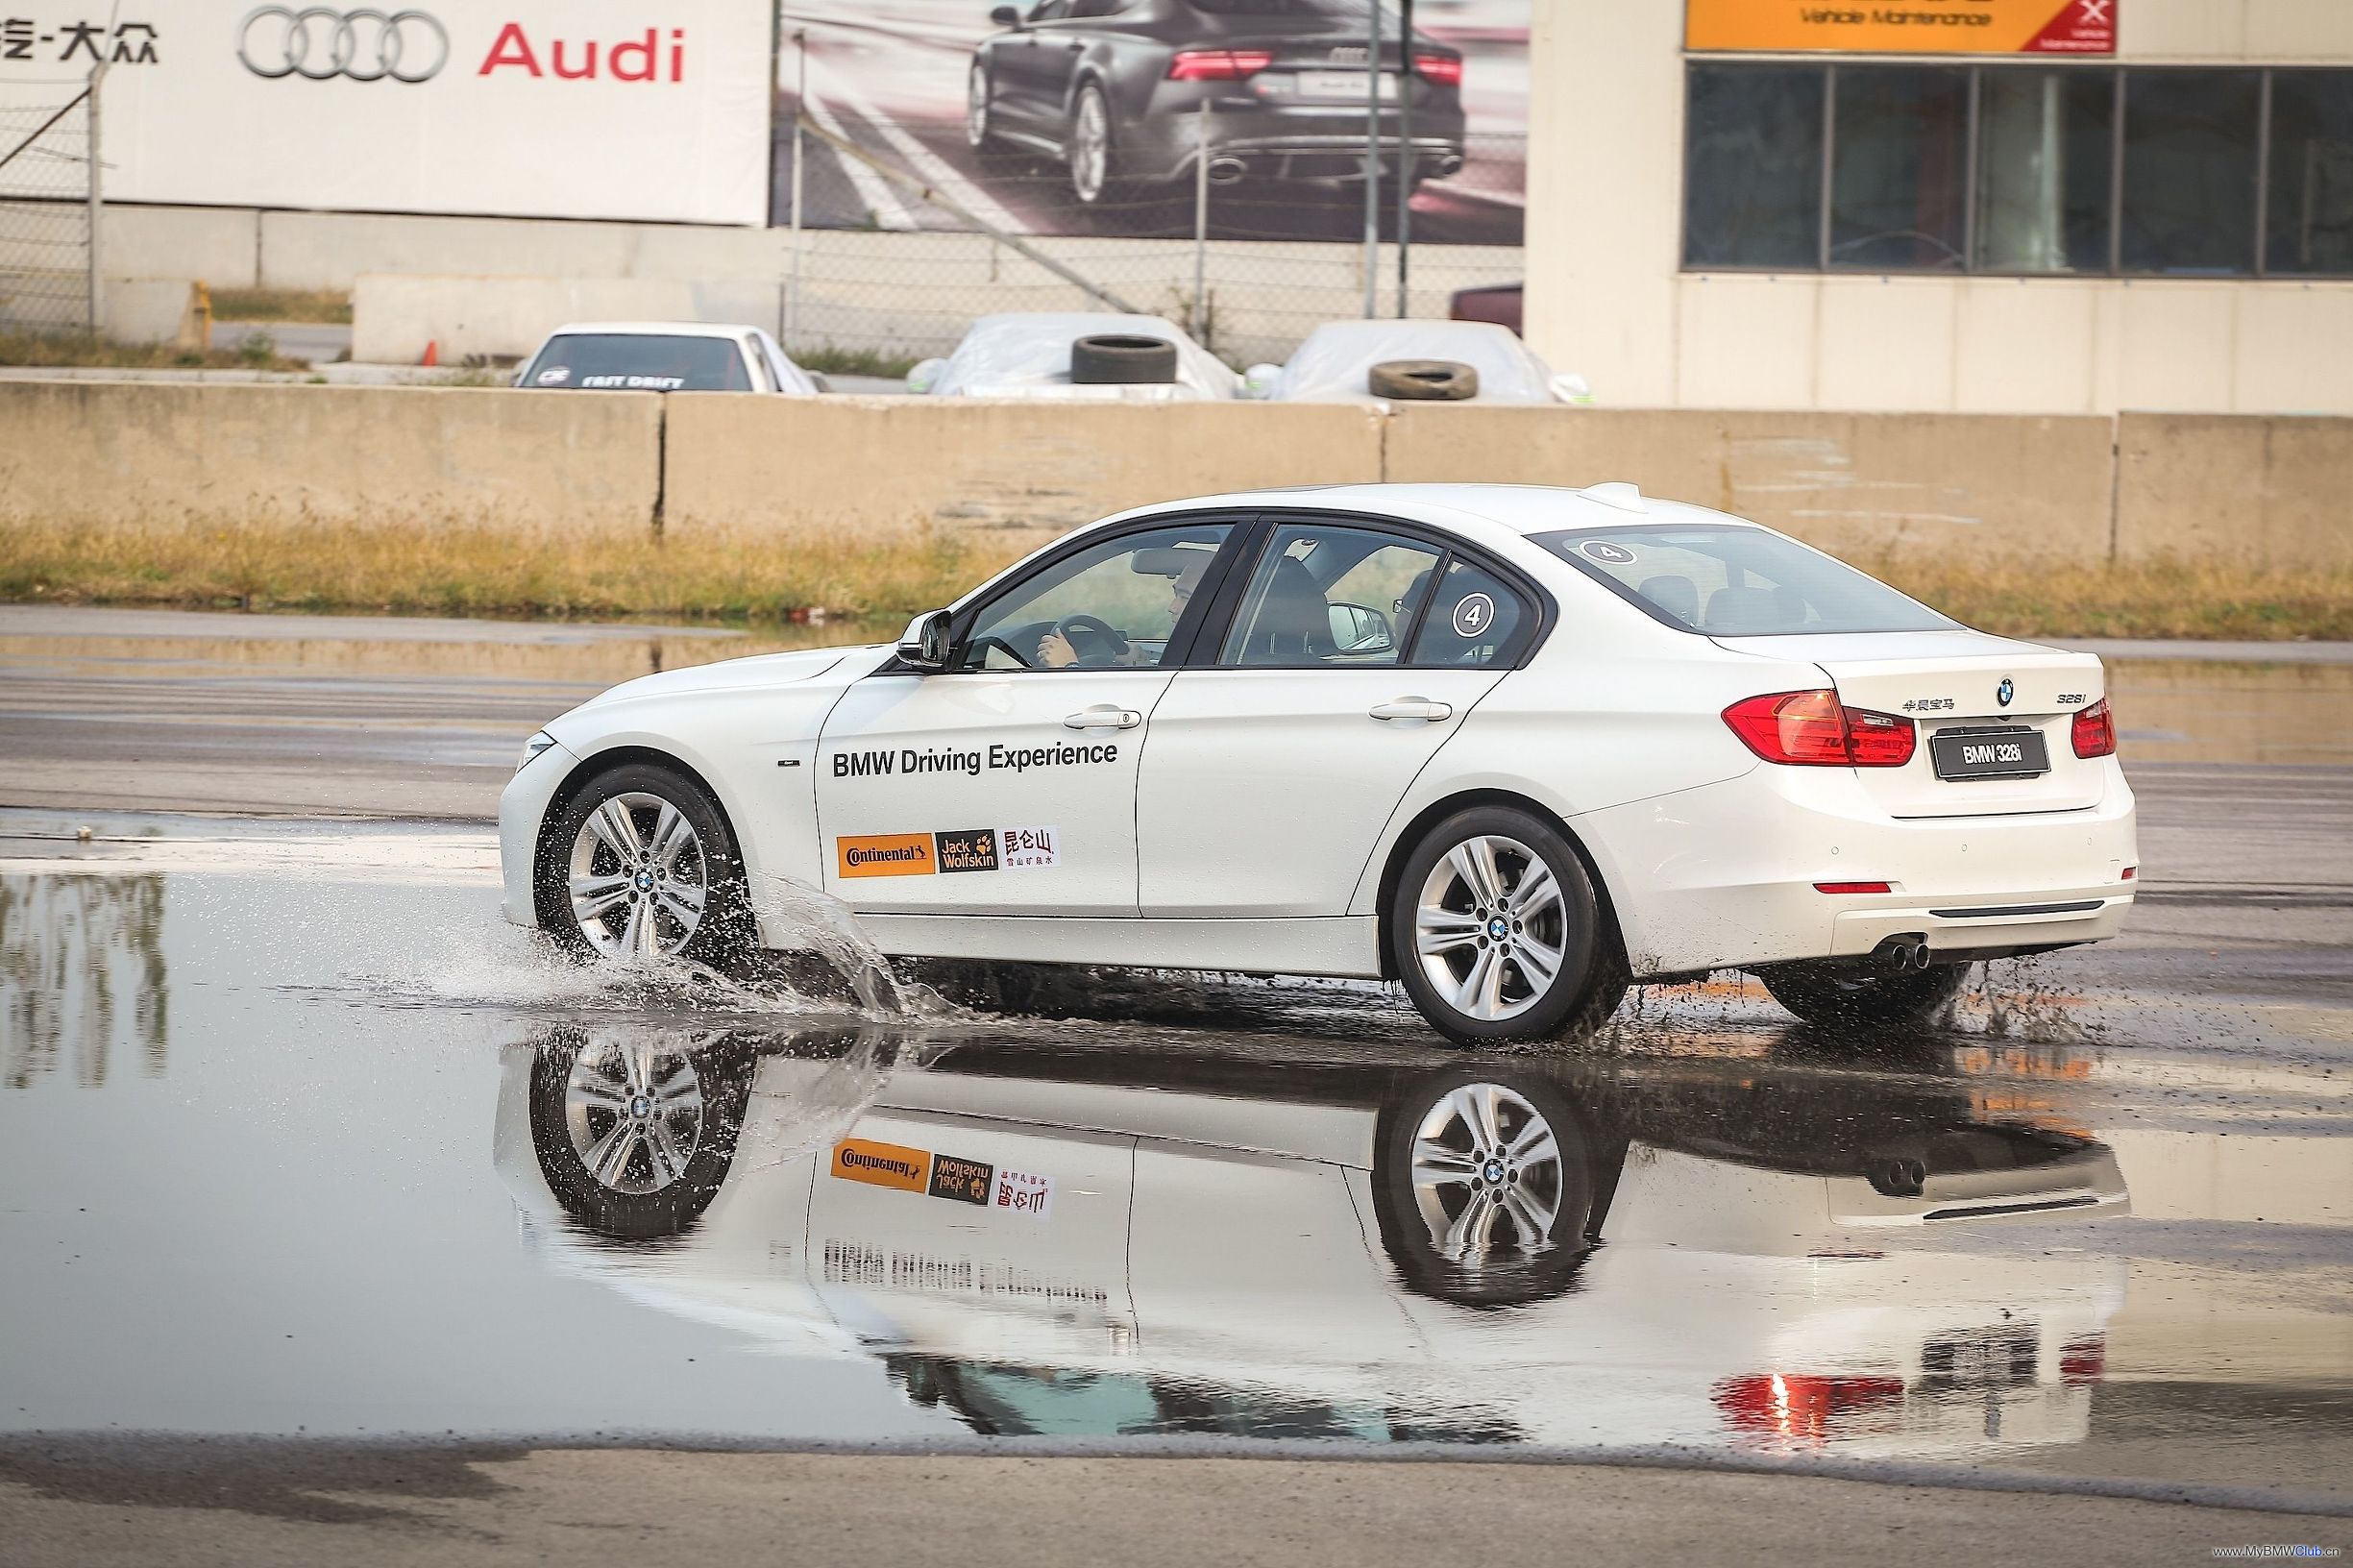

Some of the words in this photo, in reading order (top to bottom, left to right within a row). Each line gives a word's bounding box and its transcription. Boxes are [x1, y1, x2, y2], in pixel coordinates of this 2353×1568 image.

[1800, 8, 1866, 25] Vehicle
[1871, 9, 1994, 27] Maintenance
[478, 22, 684, 83] Audi
[1599, 545, 1624, 560] 4
[1463, 603, 1483, 626] 4
[1901, 698, 1955, 712] 华晨宝马
[833, 750, 895, 777] BMW
[901, 747, 981, 776] Driving
[988, 741, 1118, 772] Experience
[1962, 745, 1996, 765] BMW
[1997, 743, 2022, 763] 328i
[942, 838, 970, 855] Jack
[1004, 828, 1052, 857] 昆仑山
[846, 845, 915, 867] Continental
[944, 853, 994, 870] Wolfskin
[1006, 855, 1054, 867] 雪山矿泉水
